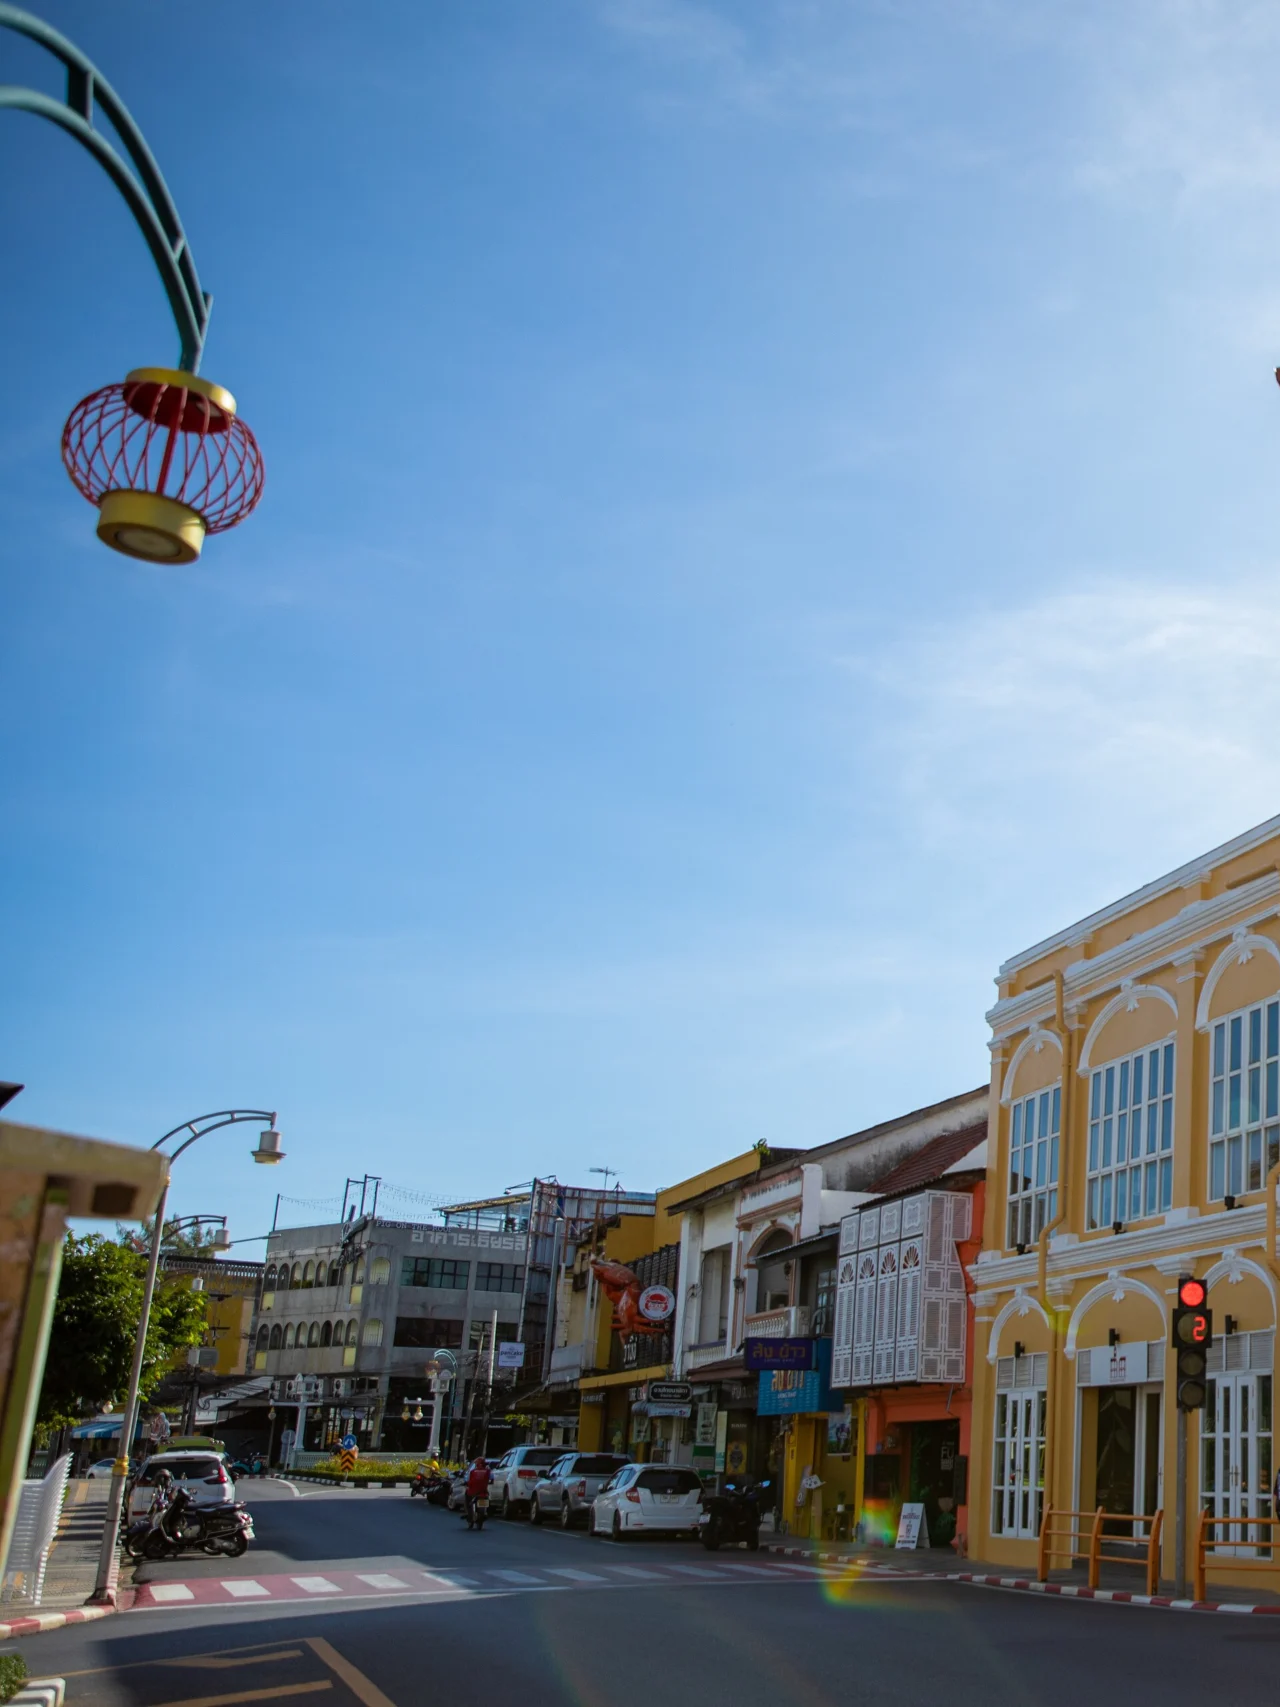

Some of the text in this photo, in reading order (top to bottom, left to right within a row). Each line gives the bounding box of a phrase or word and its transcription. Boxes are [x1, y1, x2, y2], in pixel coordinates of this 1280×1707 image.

[375, 1220, 391, 1228] PIG
[396, 1221, 407, 1229] ON
[412, 1222, 428, 1231] THE
[1193, 1316, 1206, 1341] 2
